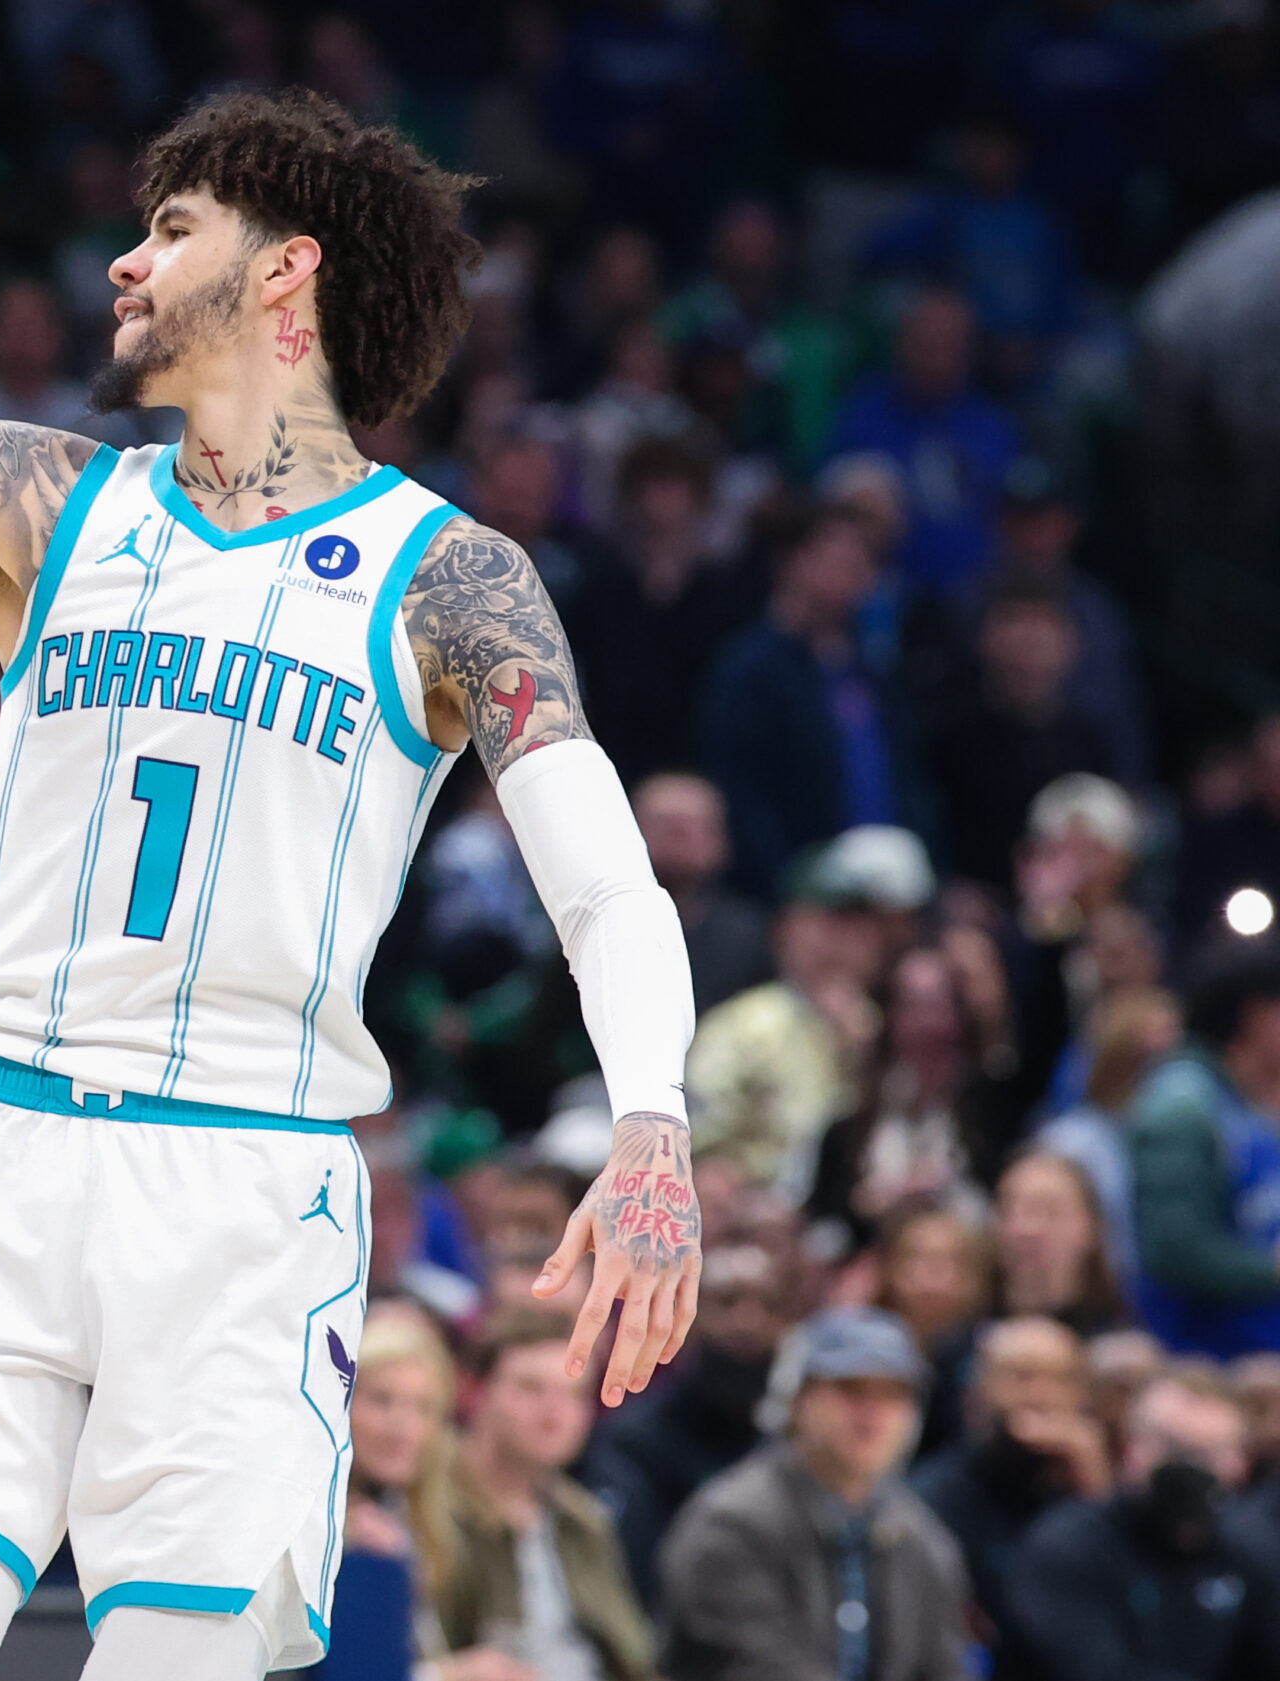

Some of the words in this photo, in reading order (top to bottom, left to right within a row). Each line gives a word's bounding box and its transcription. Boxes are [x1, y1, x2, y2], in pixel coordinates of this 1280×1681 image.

[275, 571, 315, 592] Judi
[315, 581, 368, 606] Health
[37, 630, 366, 766] CHARLOTTE
[122, 755, 200, 942] 1
[610, 1168, 652, 1199] NOT
[653, 1172, 692, 1208] FROM
[618, 1202, 690, 1248] HERE
